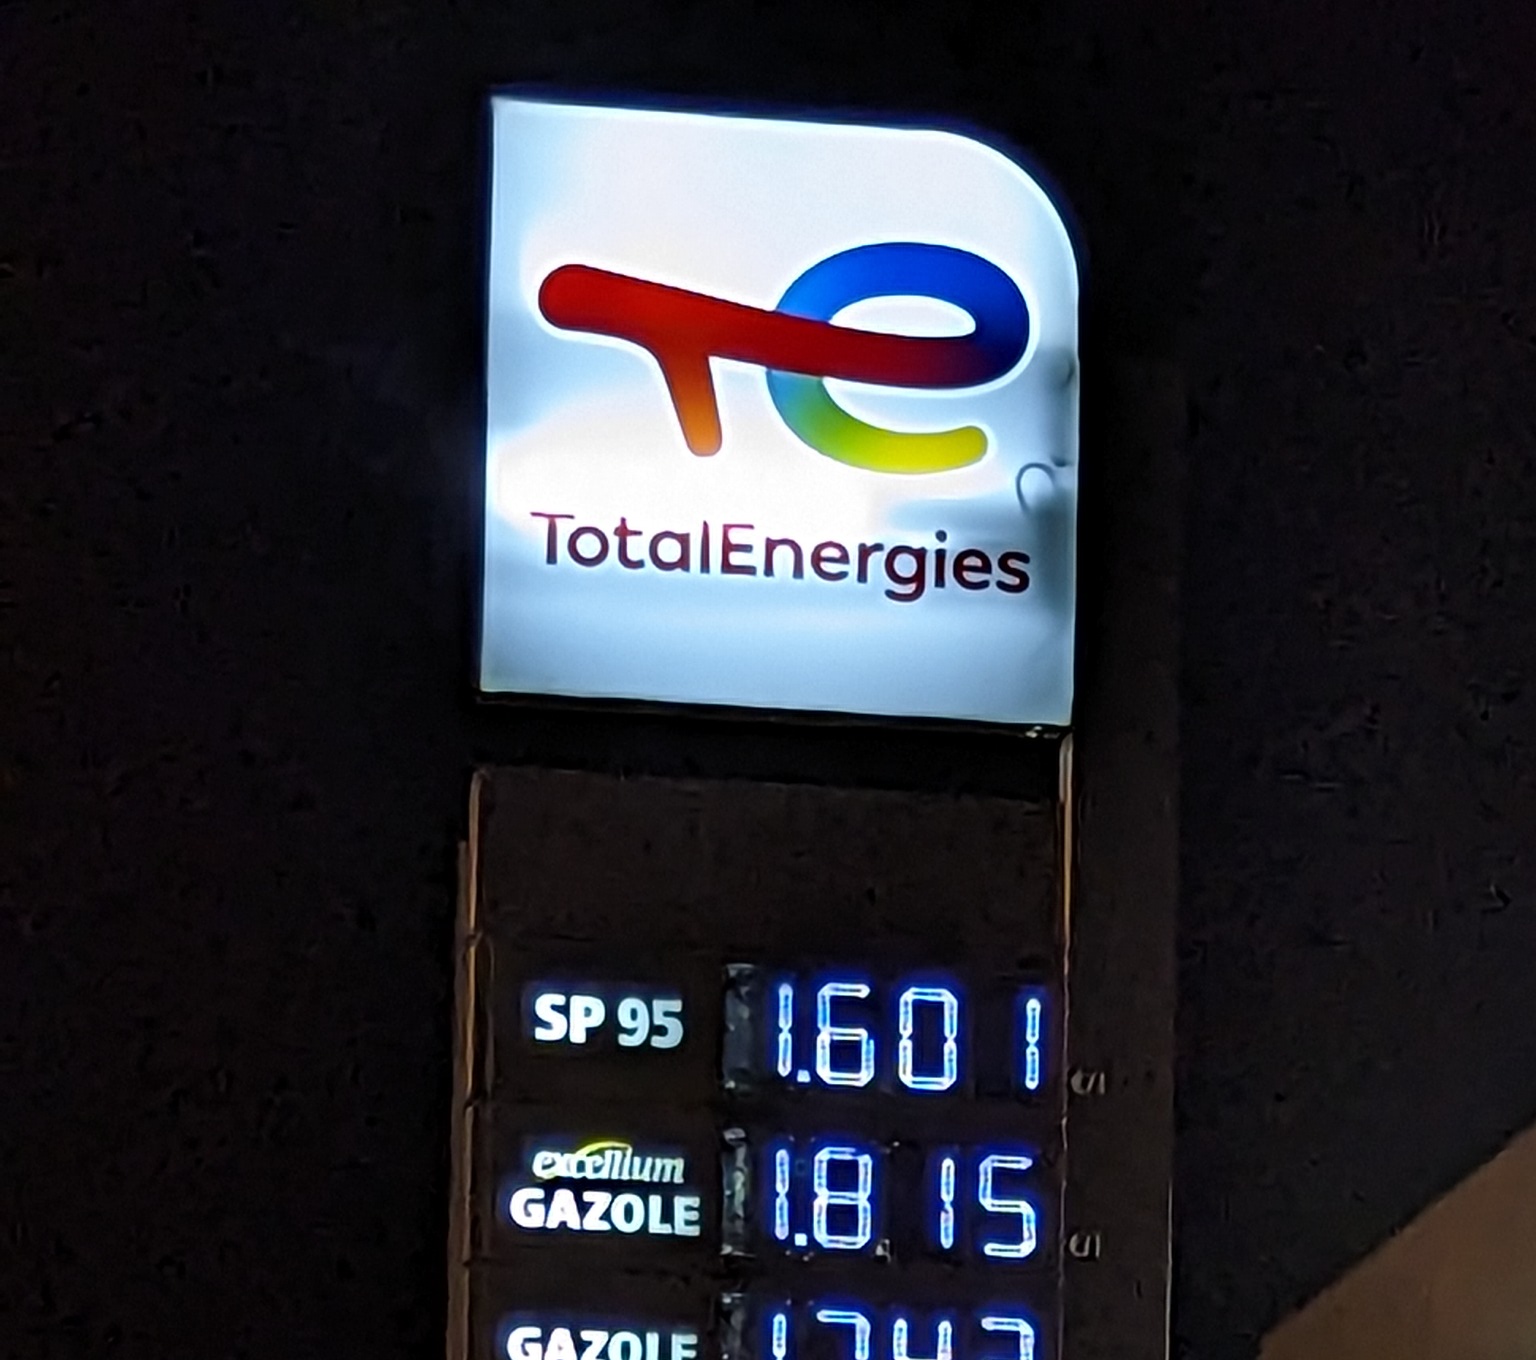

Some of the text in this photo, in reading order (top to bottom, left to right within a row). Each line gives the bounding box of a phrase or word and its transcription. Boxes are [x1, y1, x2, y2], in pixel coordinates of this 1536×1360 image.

[530, 511, 1031, 603] TotalEnergies
[533, 992, 605, 1045] SP
[616, 997, 683, 1050] 95
[775, 982, 1042, 1091] 1.601
[508, 1187, 701, 1237] GAZOLE
[772, 1145, 1037, 1259] 1.815
